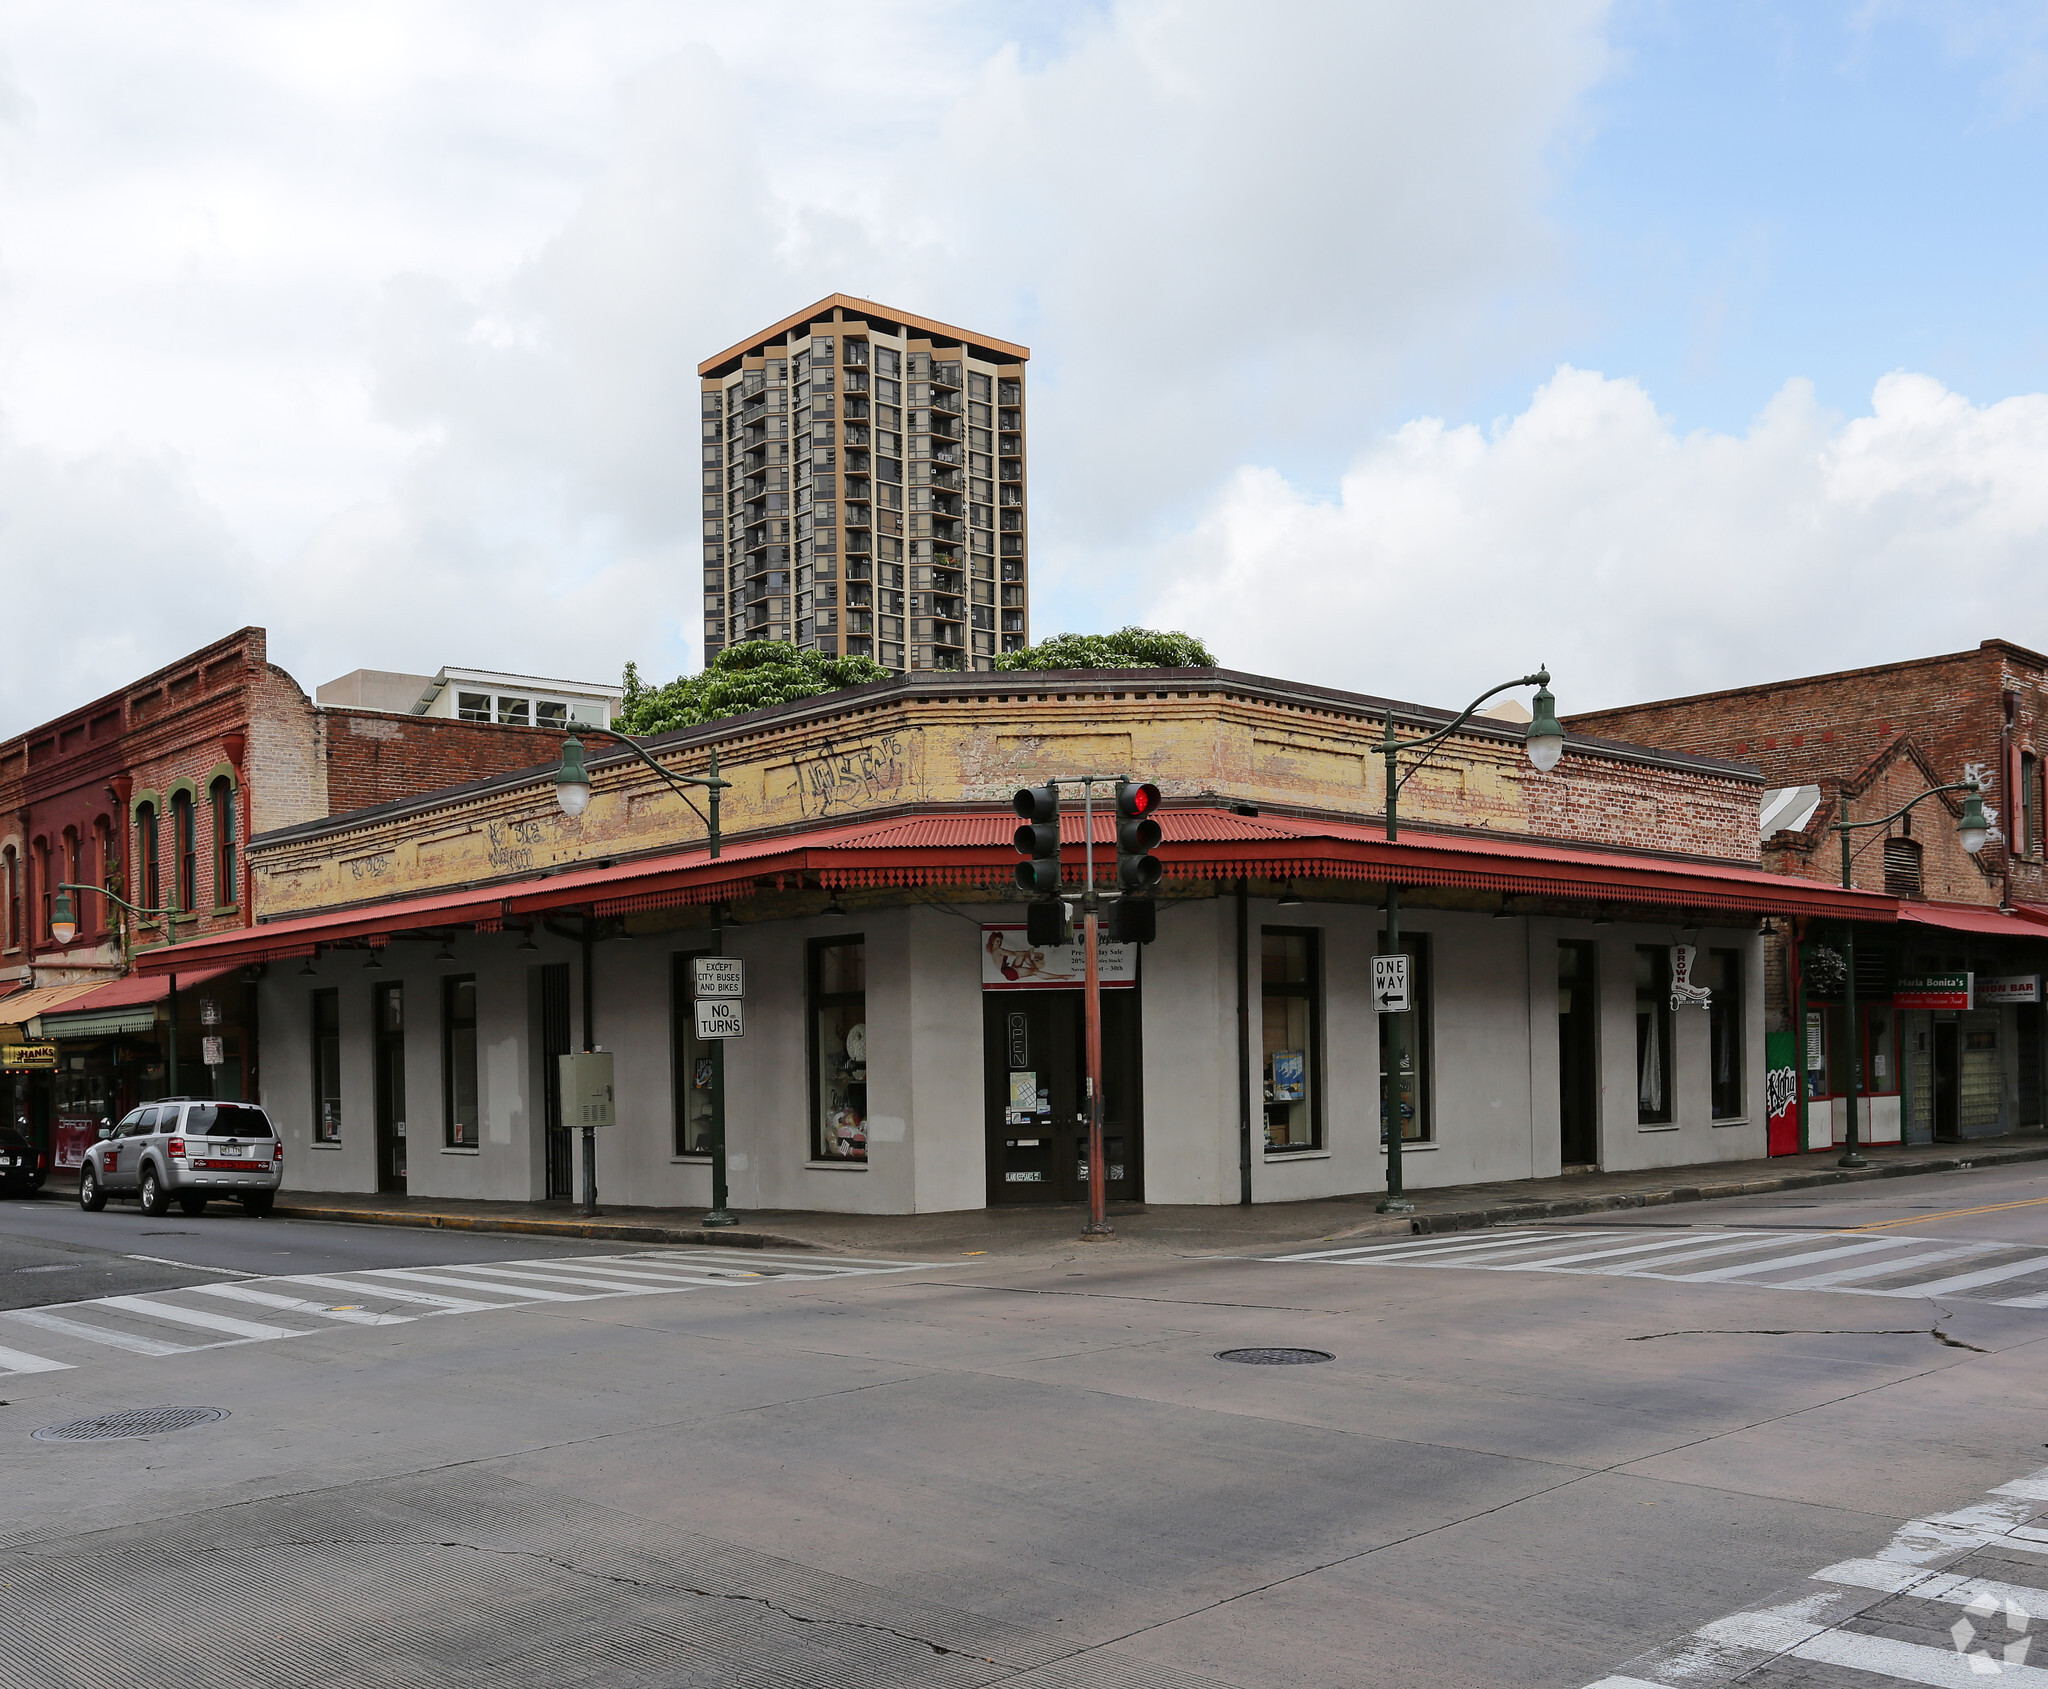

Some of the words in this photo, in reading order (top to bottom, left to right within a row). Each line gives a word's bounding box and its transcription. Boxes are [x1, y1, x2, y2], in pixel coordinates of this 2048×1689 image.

[706, 962, 733, 972] EXCEPT
[1376, 960, 1404, 974] ONE
[1676, 948, 1687, 983] BROWN
[698, 973, 714, 981] CITY
[716, 973, 741, 982] BUSES
[1376, 975, 1404, 989] WAY
[1898, 978, 1923, 987] Maria
[1926, 978, 1964, 987] Bonita's
[700, 983, 716, 992] AND
[718, 983, 740, 992] BIKES
[1975, 984, 2007, 993] NION
[2010, 983, 2034, 992] BAR
[711, 1004, 730, 1018] NO
[701, 1019, 741, 1033] TURNS
[1010, 1015, 1026, 1066] OPEN
[20, 1047, 55, 1059] HANKS
[1768, 1068, 1797, 1116] Aloha
